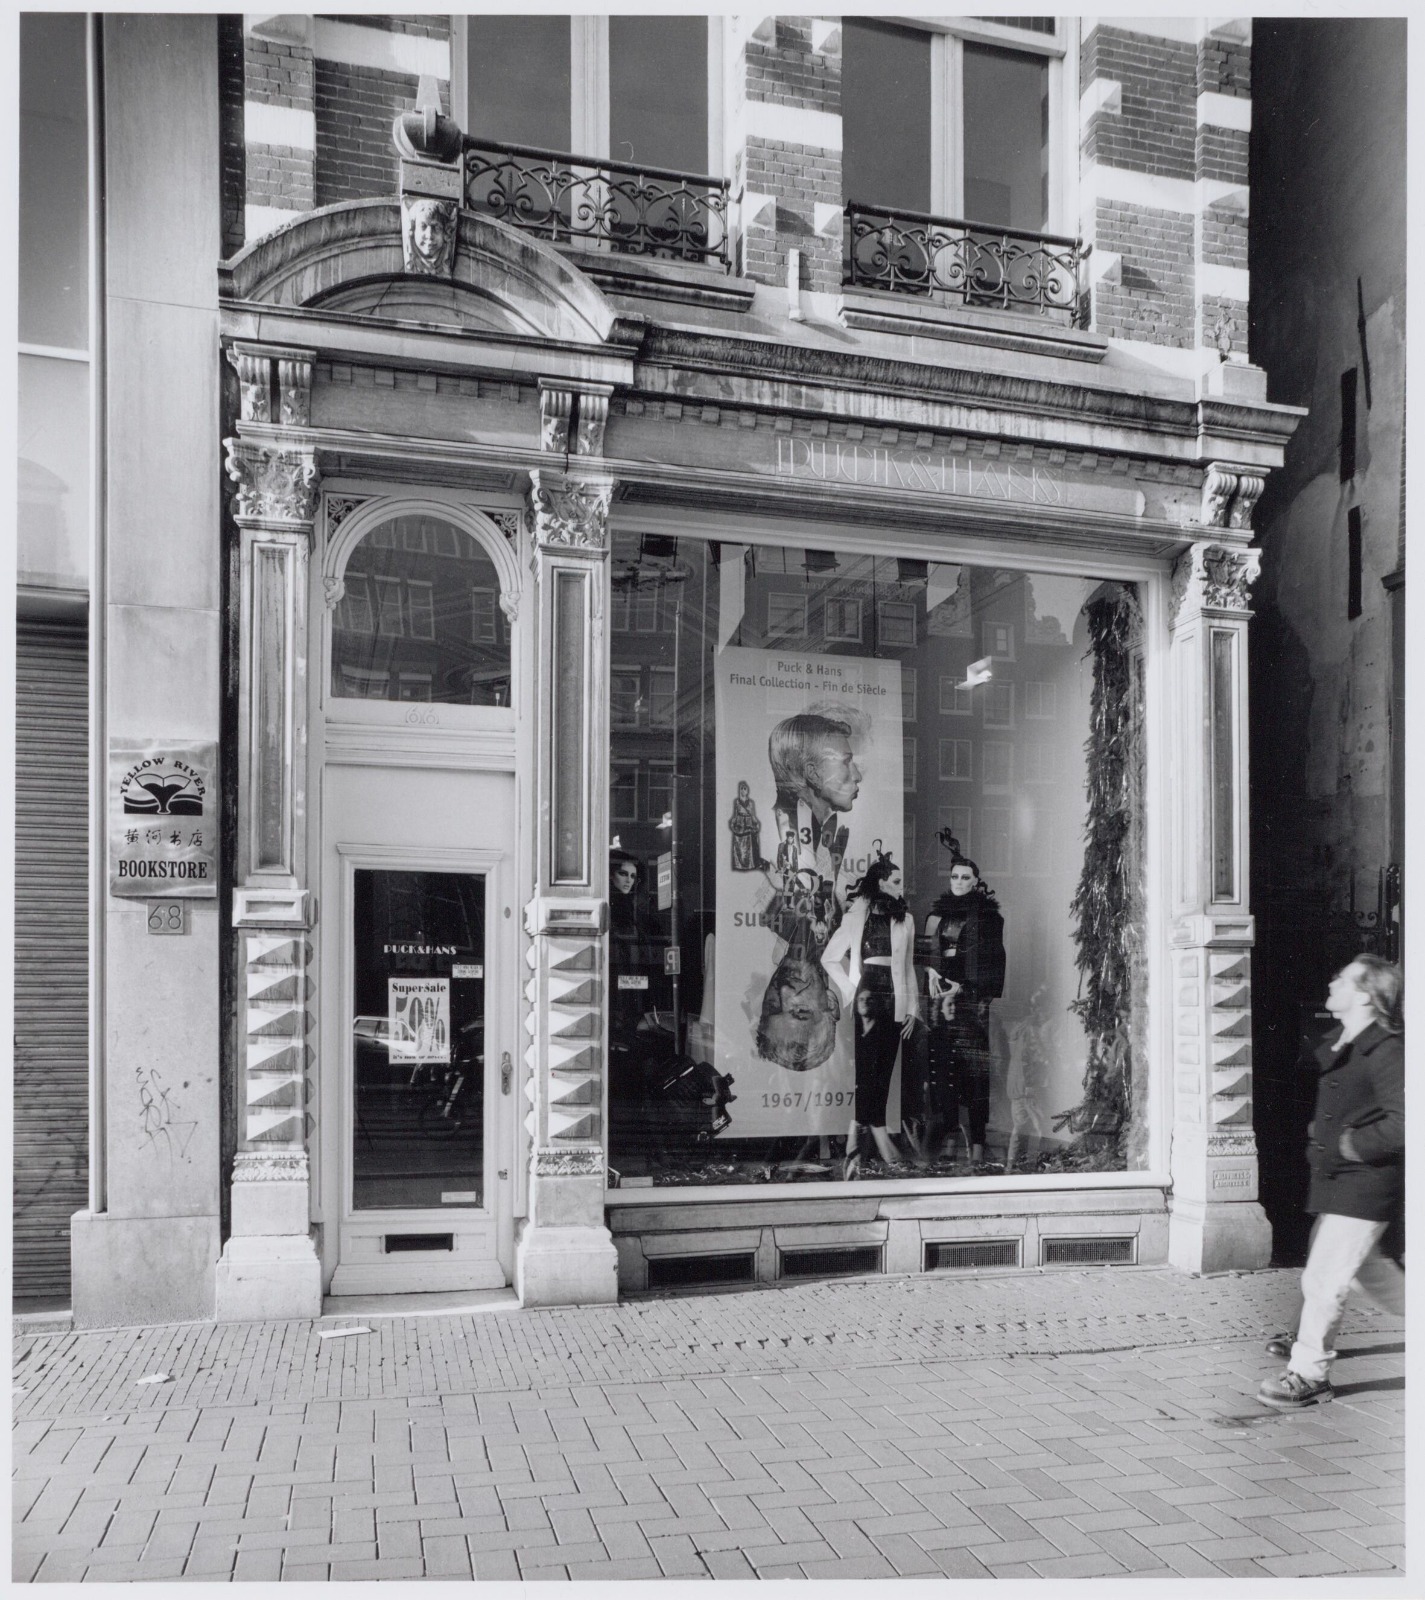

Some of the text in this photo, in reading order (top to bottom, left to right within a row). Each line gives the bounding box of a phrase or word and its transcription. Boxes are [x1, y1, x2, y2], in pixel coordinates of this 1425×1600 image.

[778, 437, 1061, 504] PUCK&HANS
[777, 661, 842, 677] Puck & Hans
[730, 673, 756, 686] Final
[759, 676, 811, 690] Collection
[822, 681, 838, 692] Fin
[842, 683, 853, 693] de
[857, 684, 887, 696] Siècle
[120, 757, 206, 797] YELLOW RIVER
[118, 859, 208, 879] BOOKSTORE
[148, 904, 181, 930] 68
[384, 944, 457, 955] PUCK&HANS
[762, 1090, 855, 1112] 1967/1997
